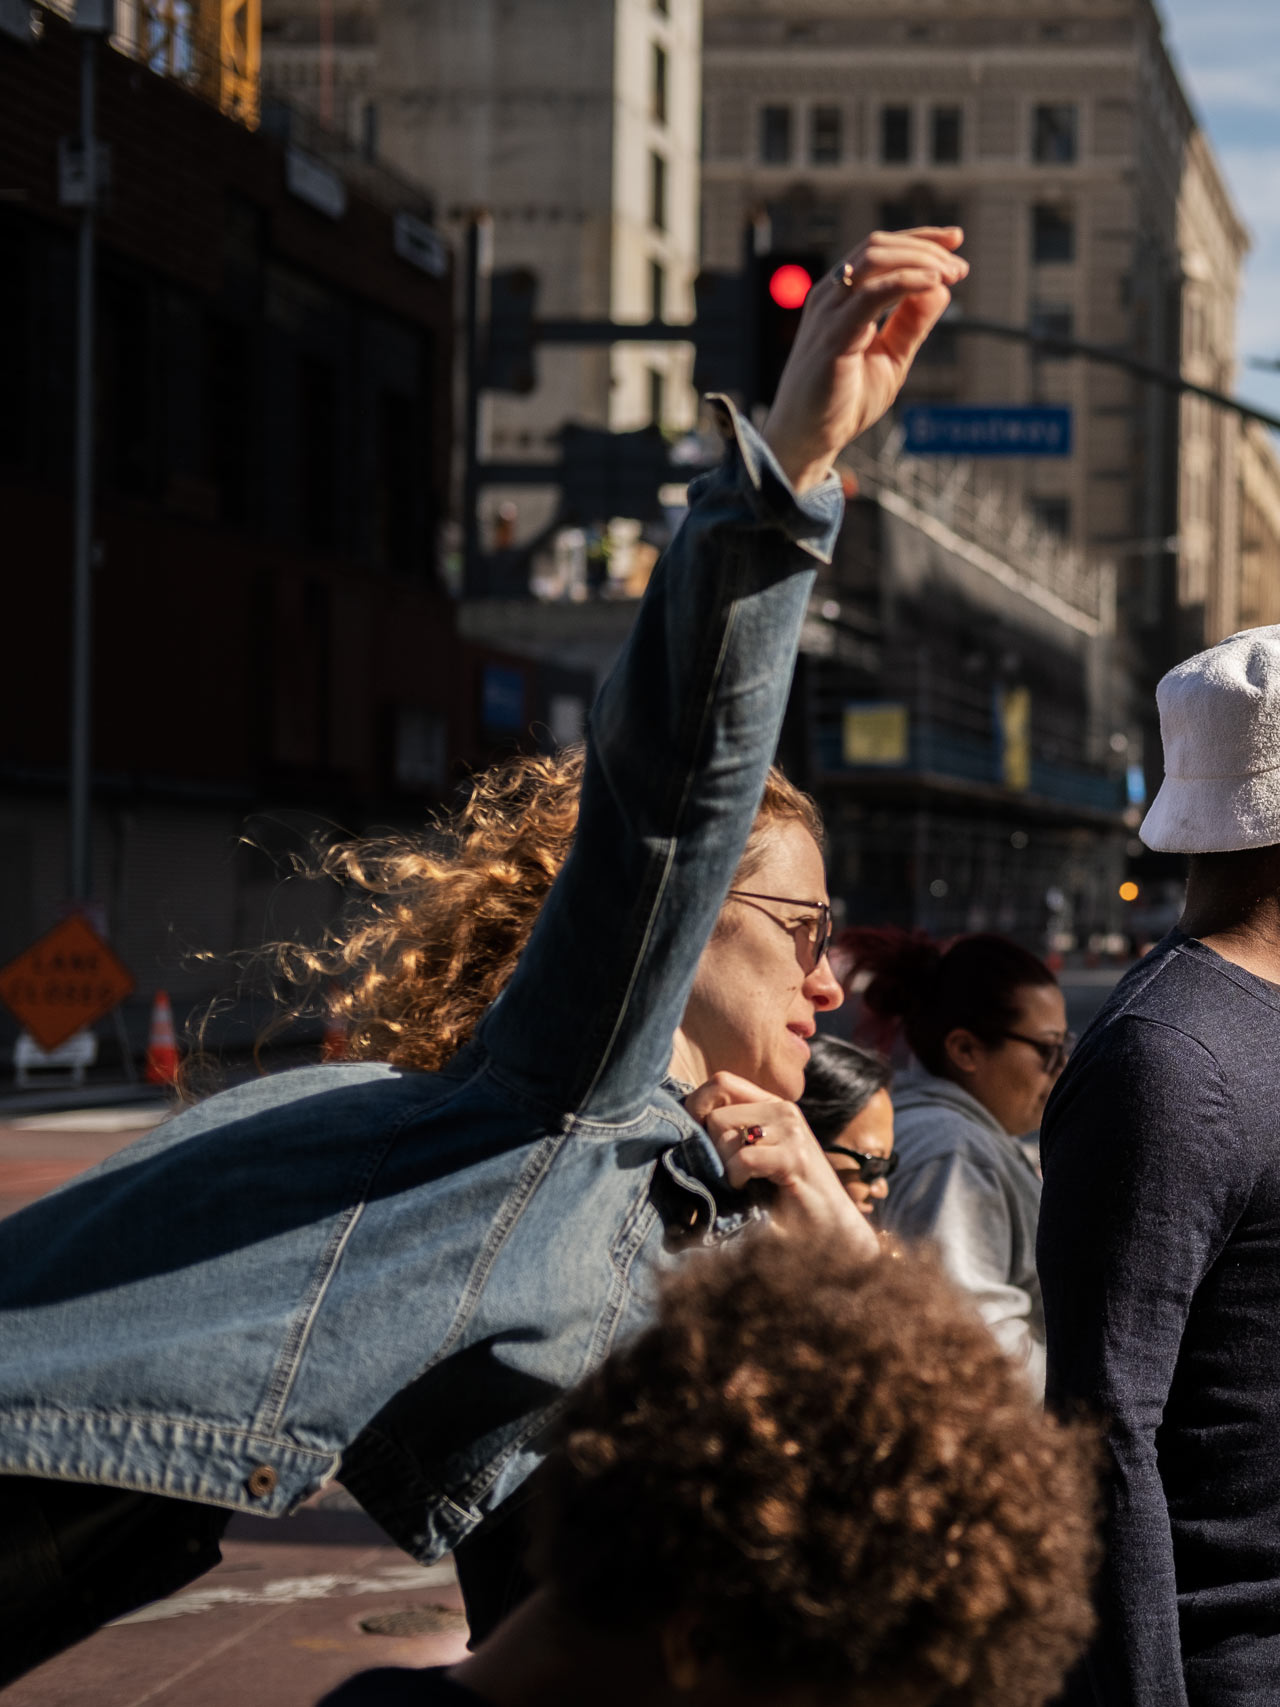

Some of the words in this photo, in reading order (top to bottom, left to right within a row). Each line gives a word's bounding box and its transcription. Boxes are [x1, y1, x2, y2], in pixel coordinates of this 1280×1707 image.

[910, 416, 1062, 445] Broadway
[32, 952, 99, 976] LANE
[8, 977, 115, 1006] CLOSED
